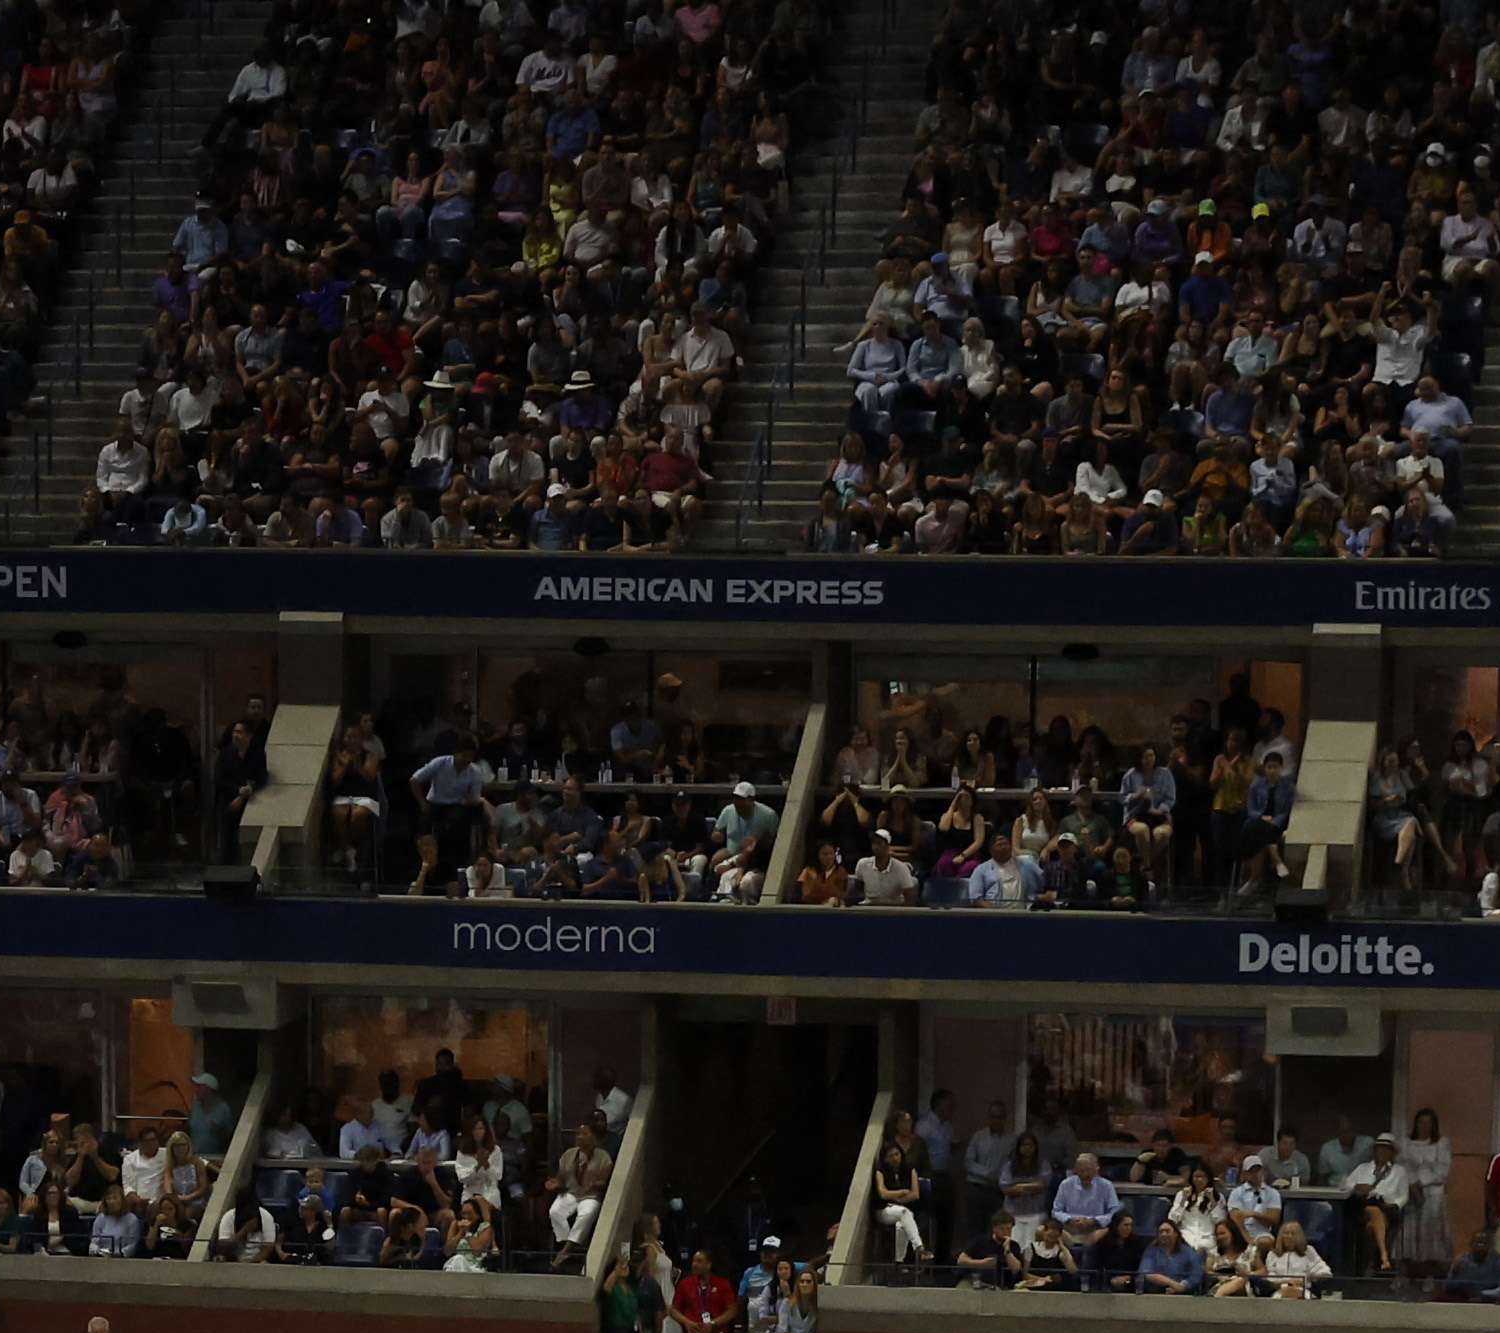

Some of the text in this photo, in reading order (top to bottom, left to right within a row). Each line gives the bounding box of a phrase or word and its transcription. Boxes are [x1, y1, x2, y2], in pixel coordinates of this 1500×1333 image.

[534, 577, 883, 604] AMERICAN EXPRESS
[1356, 581, 1490, 609] Emirates
[454, 916, 654, 953] moderna
[1239, 934, 1434, 975] Deloitte.
